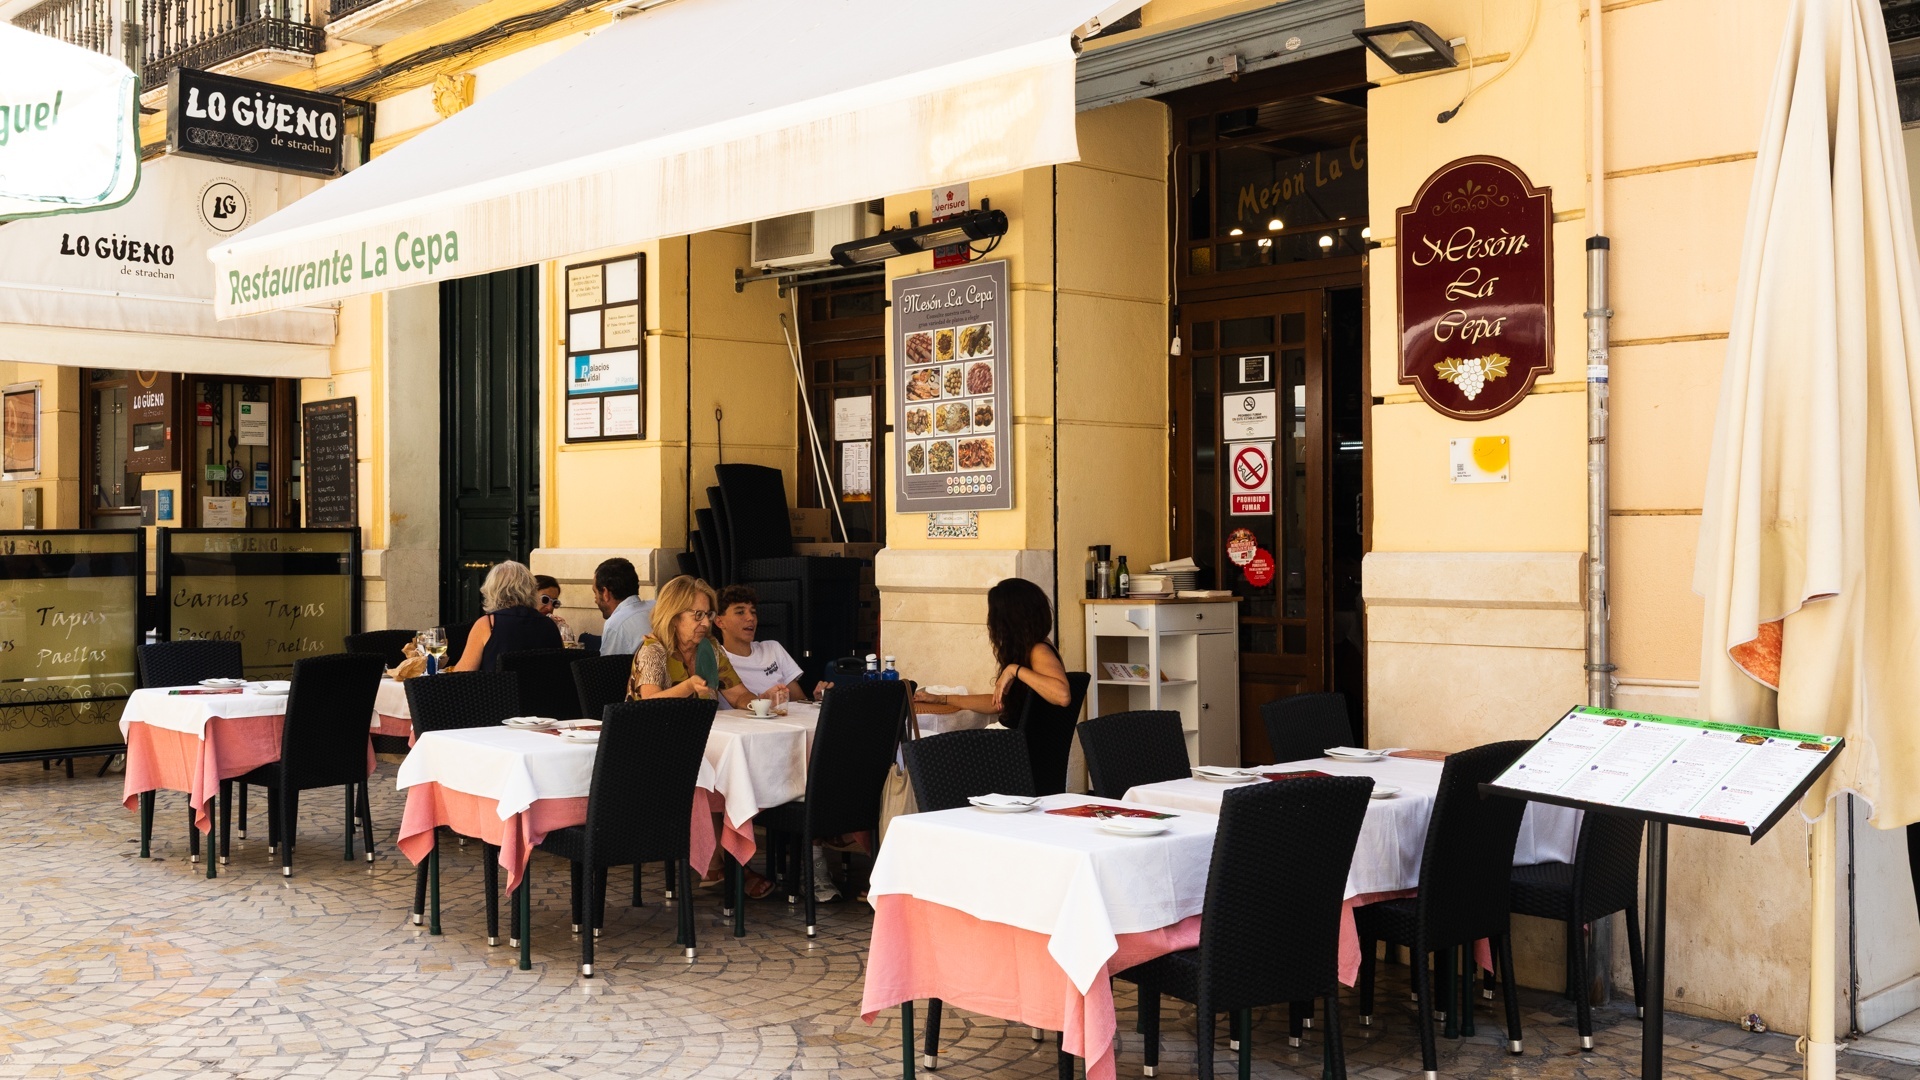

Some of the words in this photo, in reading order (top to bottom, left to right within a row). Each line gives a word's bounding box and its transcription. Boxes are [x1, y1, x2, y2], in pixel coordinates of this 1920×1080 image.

[186, 87, 228, 122] LO
[232, 92, 337, 142] GÜENO
[271, 134, 284, 148] de
[287, 139, 332, 155] strachan
[1315, 151, 1343, 187] La
[935, 200, 965, 212] verisure
[61, 233, 90, 256] LO
[95, 234, 175, 267] GÜENO
[121, 265, 133, 276] de
[135, 267, 175, 280] strachan
[229, 250, 352, 304] Restaurante
[360, 244, 389, 281] La
[395, 230, 460, 277] Cepa
[1445, 267, 1500, 302] La
[904, 293, 943, 314] Mesón
[945, 287, 964, 308] La
[966, 284, 994, 310] Cepa
[1433, 309, 1507, 345] Cepa
[581, 363, 610, 379] Palacios
[133, 395, 142, 410] LO
[142, 391, 165, 408] GÜENO
[1236, 495, 1266, 503] PROHIBIDO
[1241, 503, 1261, 511] FUMAR
[173, 588, 249, 609] Carnes
[37, 605, 106, 640] Tapas
[265, 599, 325, 630] Tapas
[265, 637, 325, 655] Paellas
[37, 646, 107, 668] Paellas
[1642, 713, 1664, 722] Cepa
